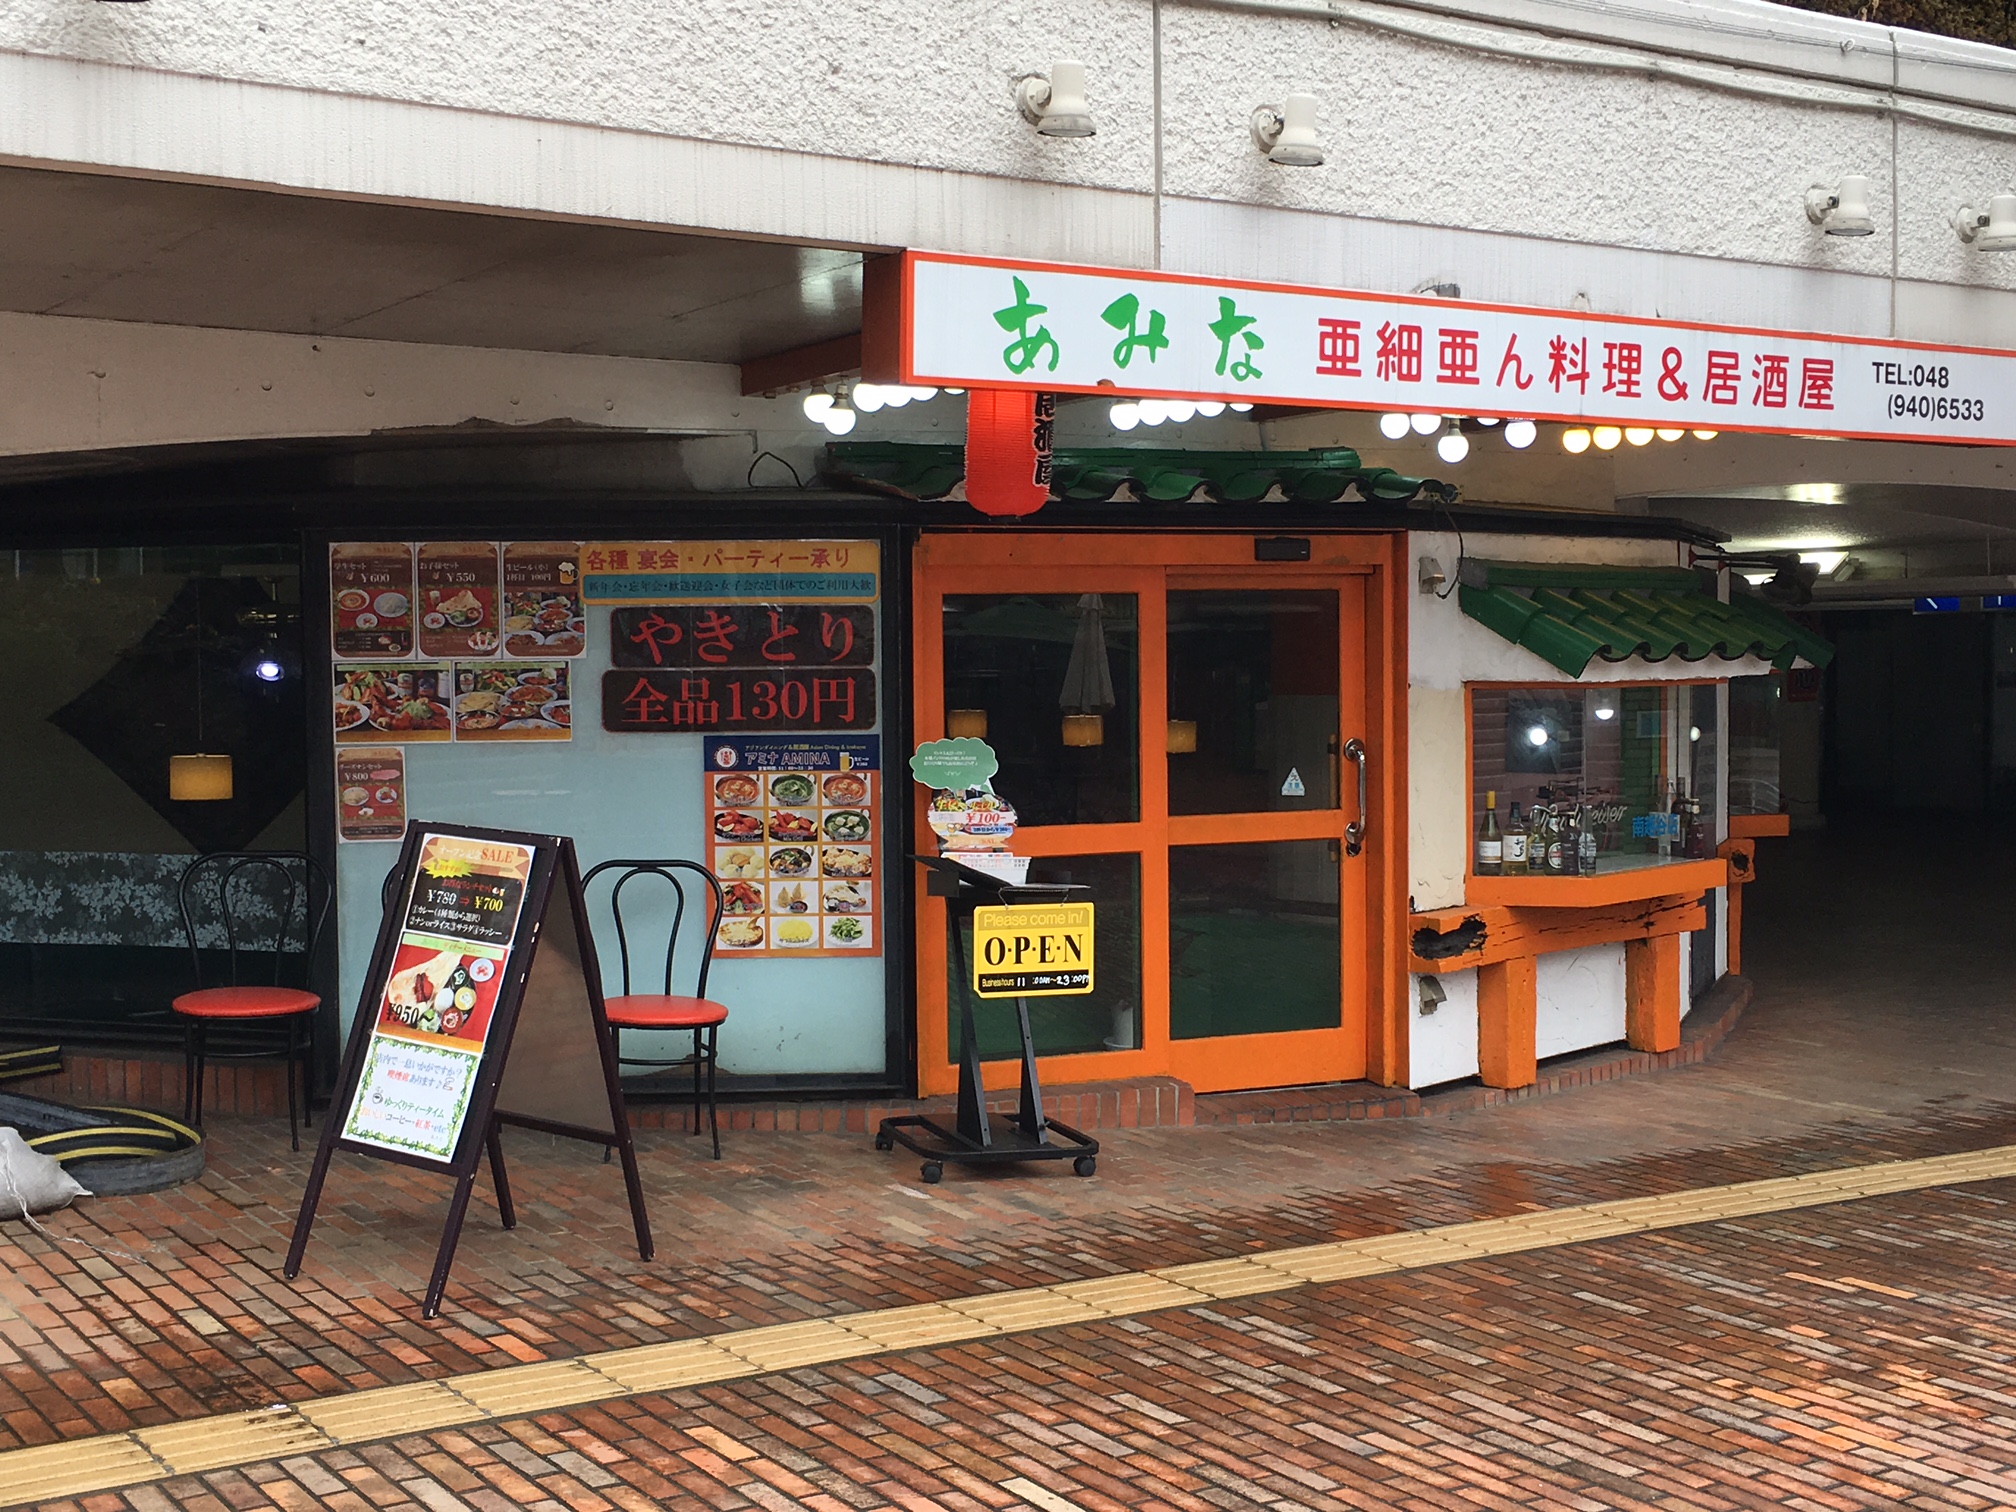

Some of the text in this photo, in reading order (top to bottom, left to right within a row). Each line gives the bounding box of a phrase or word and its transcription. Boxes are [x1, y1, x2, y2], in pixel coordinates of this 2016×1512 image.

[992, 275, 1835, 411] あみな 亜細亜ん料理&居酒屋
[1872, 361, 1950, 389] TEL:048
[1887, 393, 1985, 423] (940)6533
[586, 548, 849, 571] 各種 宴会・パーティー承り
[630, 611, 854, 665] やきとり
[621, 677, 856, 726] 全品130円
[744, 751, 779, 765] アミナ
[780, 751, 831, 765] AMINA
[427, 889, 504, 912] ¥780 ¥700
[984, 910, 1084, 927] Please come in!
